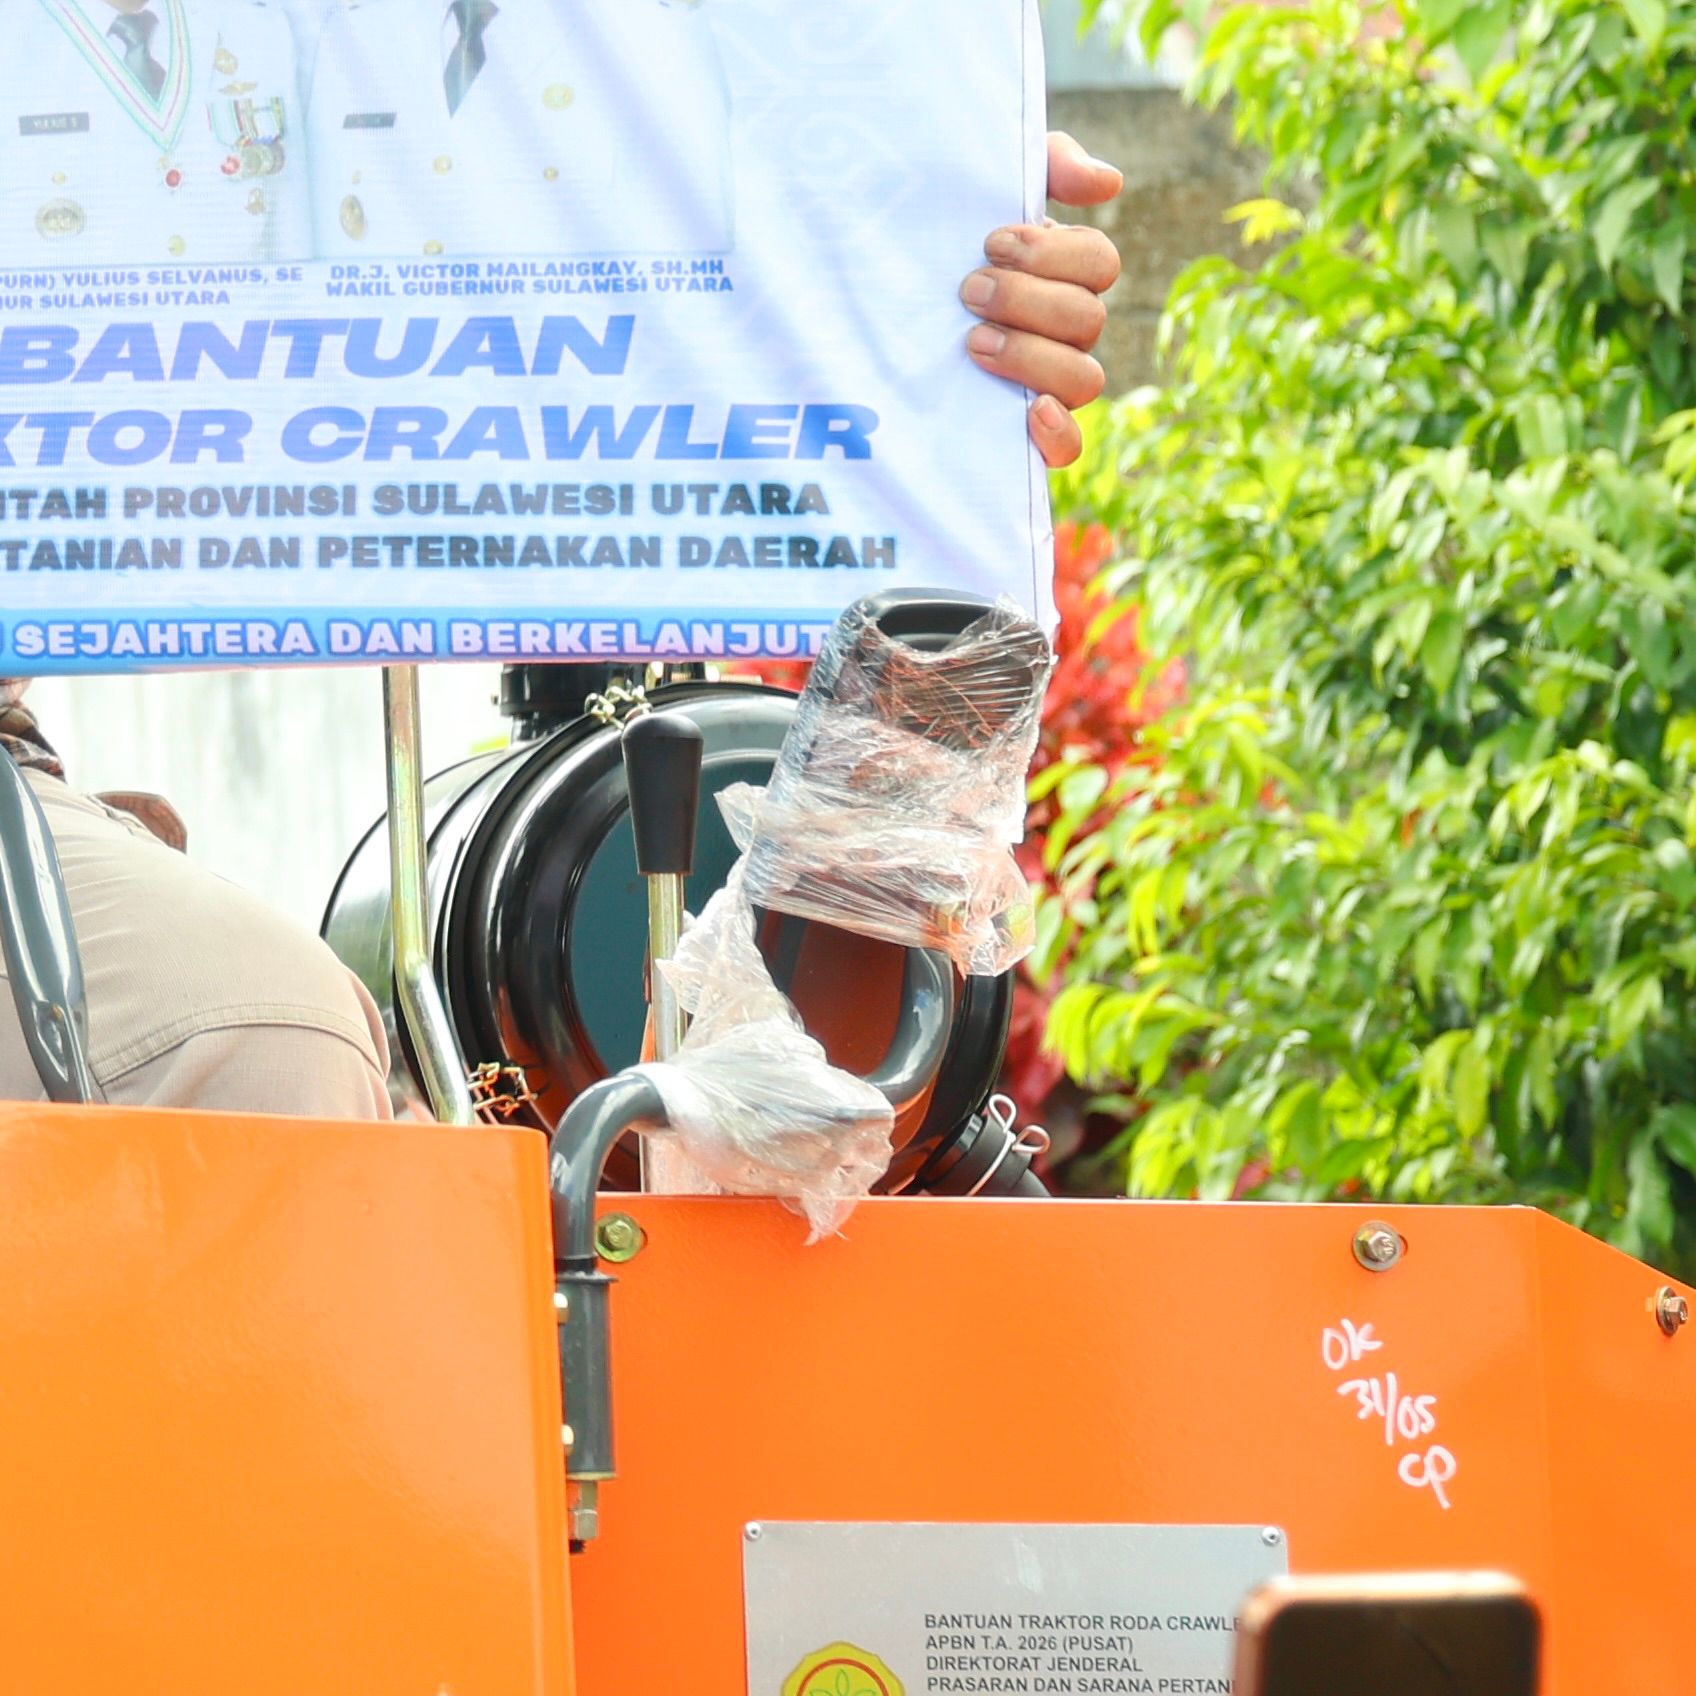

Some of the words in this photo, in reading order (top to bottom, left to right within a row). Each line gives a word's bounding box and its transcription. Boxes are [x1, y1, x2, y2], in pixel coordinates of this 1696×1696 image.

[62, 271, 141, 289] YULIUS
[147, 268, 270, 287] SELVANUS,
[275, 266, 305, 282] SE
[330, 264, 391, 280] DR.J.
[396, 263, 480, 280] VICTOR
[650, 260, 725, 276] SH.MH
[325, 280, 397, 297] WAKIL
[404, 278, 526, 295] GUBERNUR
[532, 276, 650, 295] SULAWESI
[655, 275, 735, 293] UTARA
[39, 292, 150, 310] SULAWESI
[155, 290, 232, 307] UTARA
[279, 402, 880, 462] CRAWLER
[123, 485, 356, 518] PROVINSI
[373, 483, 634, 516] SULAWESI
[651, 483, 830, 516] UTARA
[197, 536, 300, 570] DAN
[317, 535, 661, 568] PETERNAKAN
[678, 535, 896, 569] DAERAH
[14, 623, 314, 656] SEJAHTERA
[330, 623, 435, 654] DAN
[451, 622, 832, 656] BERKELANJUT
[925, 1614, 1012, 1630] BANTUAN
[1018, 1615, 1105, 1630] TRAKTOR
[1110, 1615, 1162, 1631] RODA
[926, 1635, 976, 1651] APBN
[981, 1636, 1012, 1651] T.A.
[1018, 1636, 1057, 1651] 2026
[1062, 1636, 1134, 1654] (PUSAT)
[927, 1656, 1042, 1671] DIREKTORAT
[1046, 1657, 1143, 1672] JENDERAL
[927, 1678, 1028, 1693] PRASARAN
[1034, 1678, 1072, 1693] DAN
[1078, 1678, 1154, 1693] SARANA
